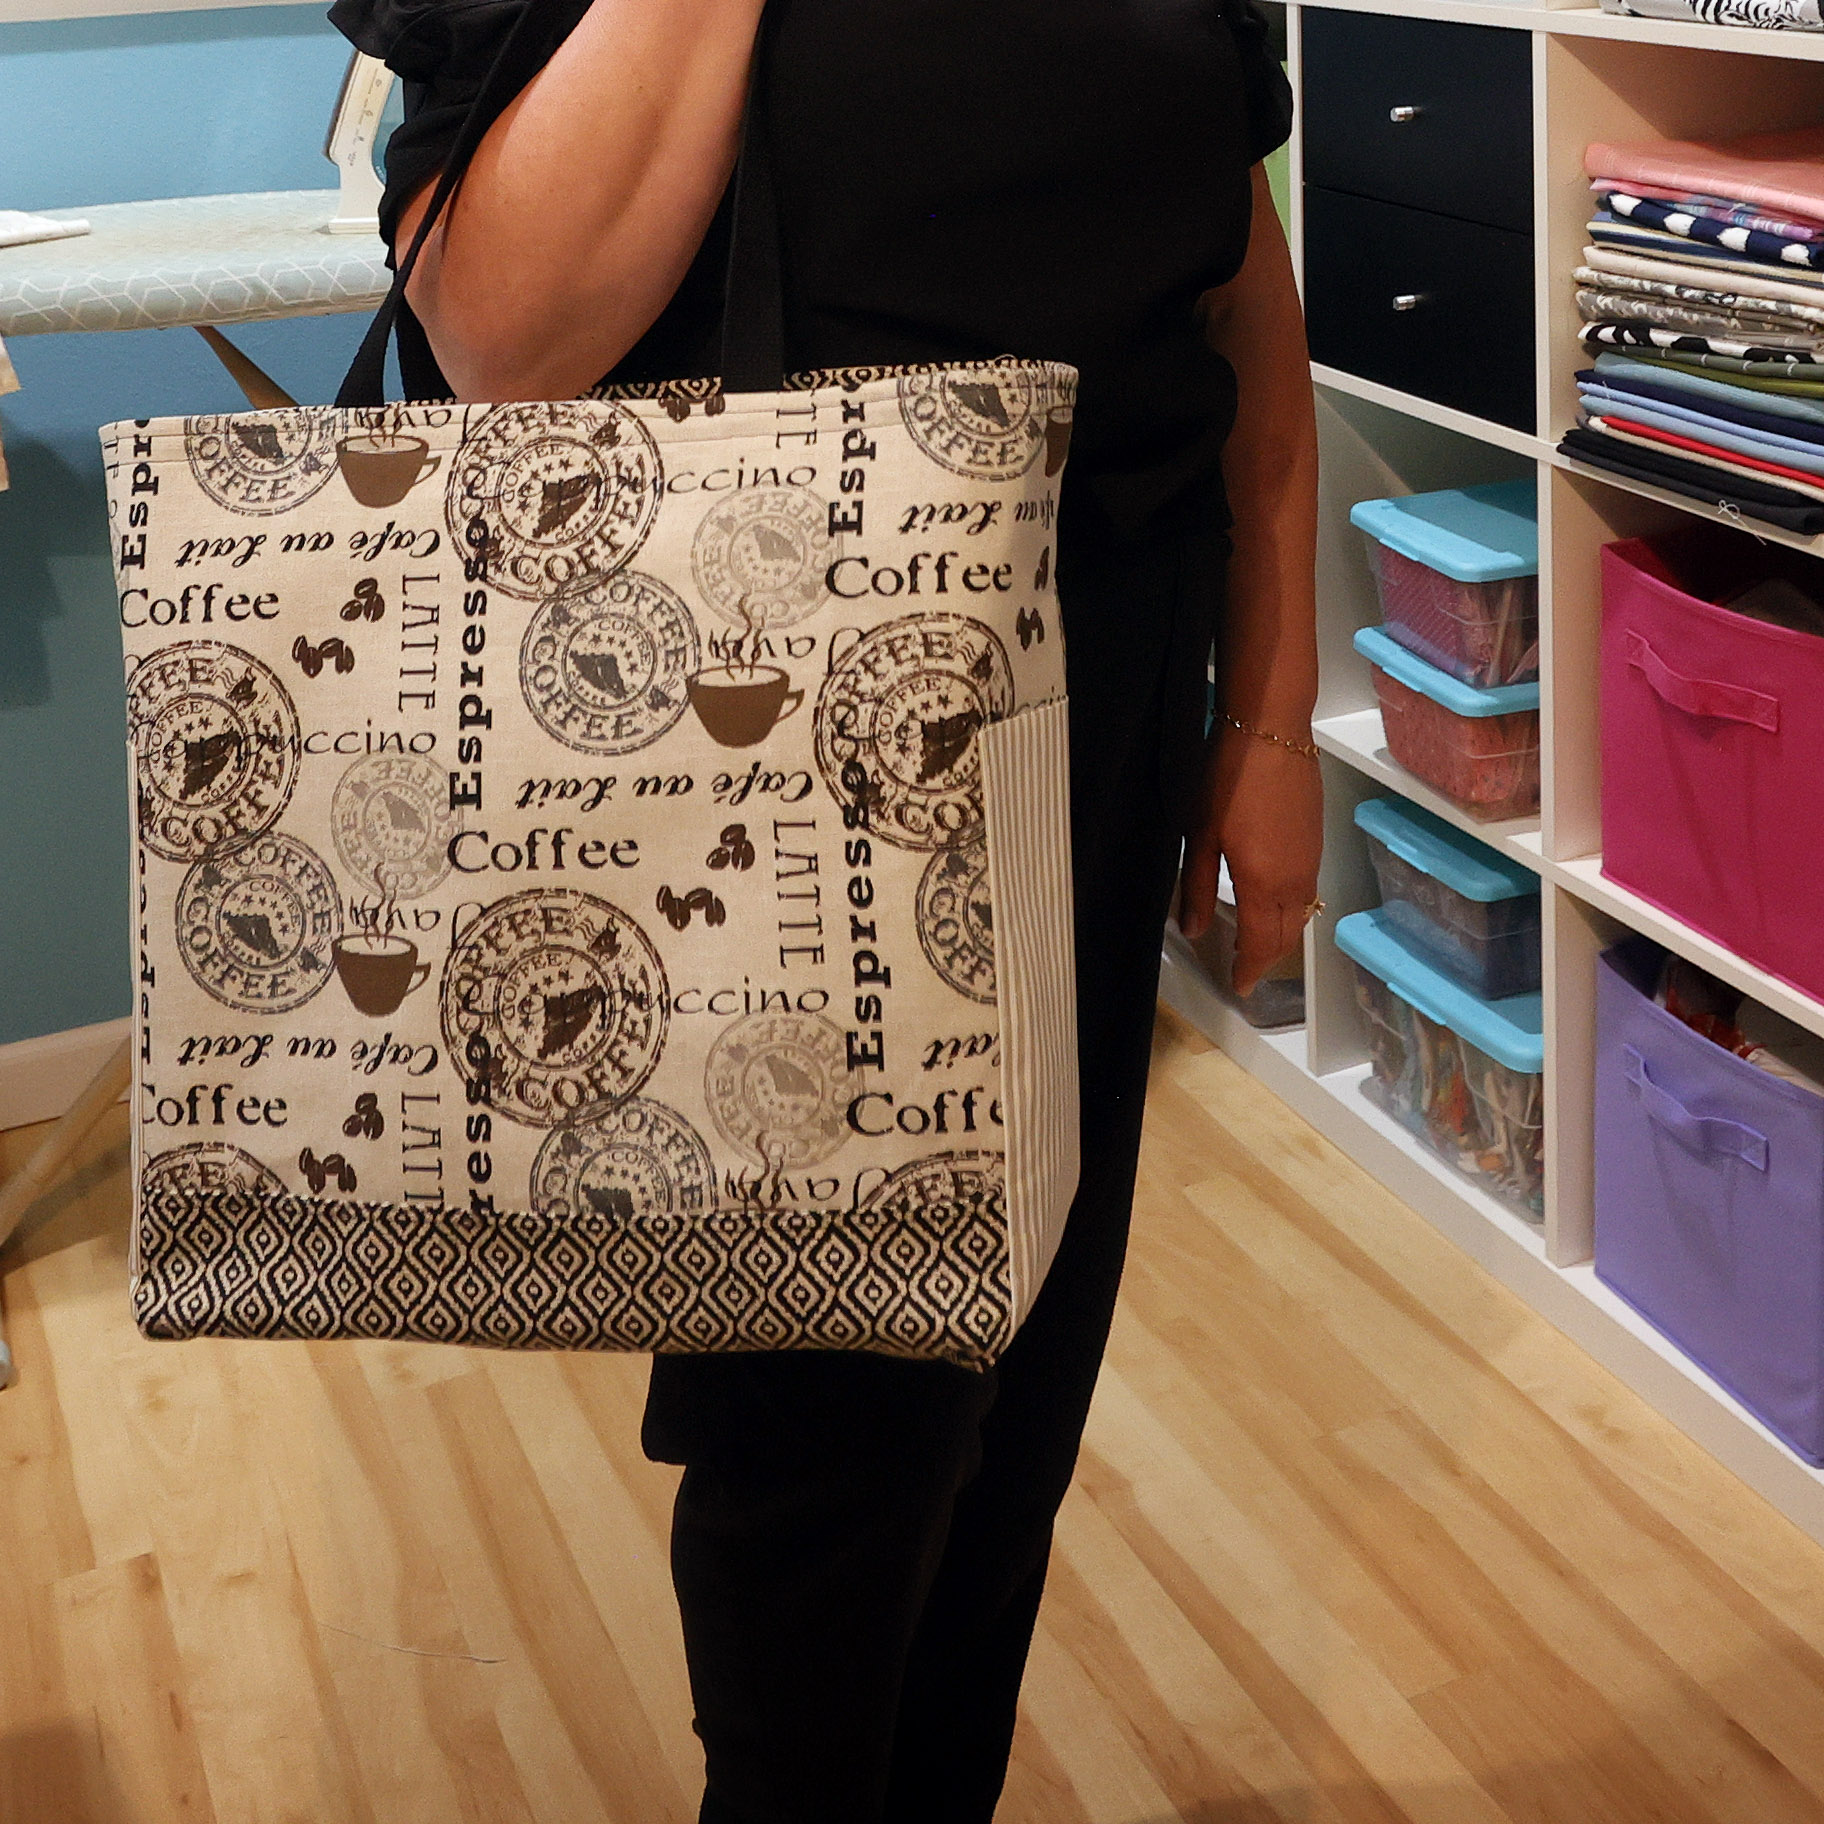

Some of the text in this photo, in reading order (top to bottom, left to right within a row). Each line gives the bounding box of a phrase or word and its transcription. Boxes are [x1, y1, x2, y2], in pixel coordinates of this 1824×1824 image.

[501, 442, 564, 505] COFFEE
[282, 531, 335, 555] au
[825, 550, 1014, 599] Coffee
[119, 582, 281, 628] Coffee
[398, 572, 441, 714] LATTE
[448, 517, 493, 812] Espresso
[531, 633, 645, 741] COFFEE
[875, 675, 944, 748] COFFEE
[150, 700, 205, 765] COFFEE
[631, 773, 695, 799] au
[446, 827, 641, 873] Coffee
[771, 818, 827, 972] LATTE
[840, 756, 893, 1074] Espresso
[186, 894, 299, 1001] COFFEE
[500, 951, 563, 1022] COFFEE
[286, 1035, 337, 1059] au
